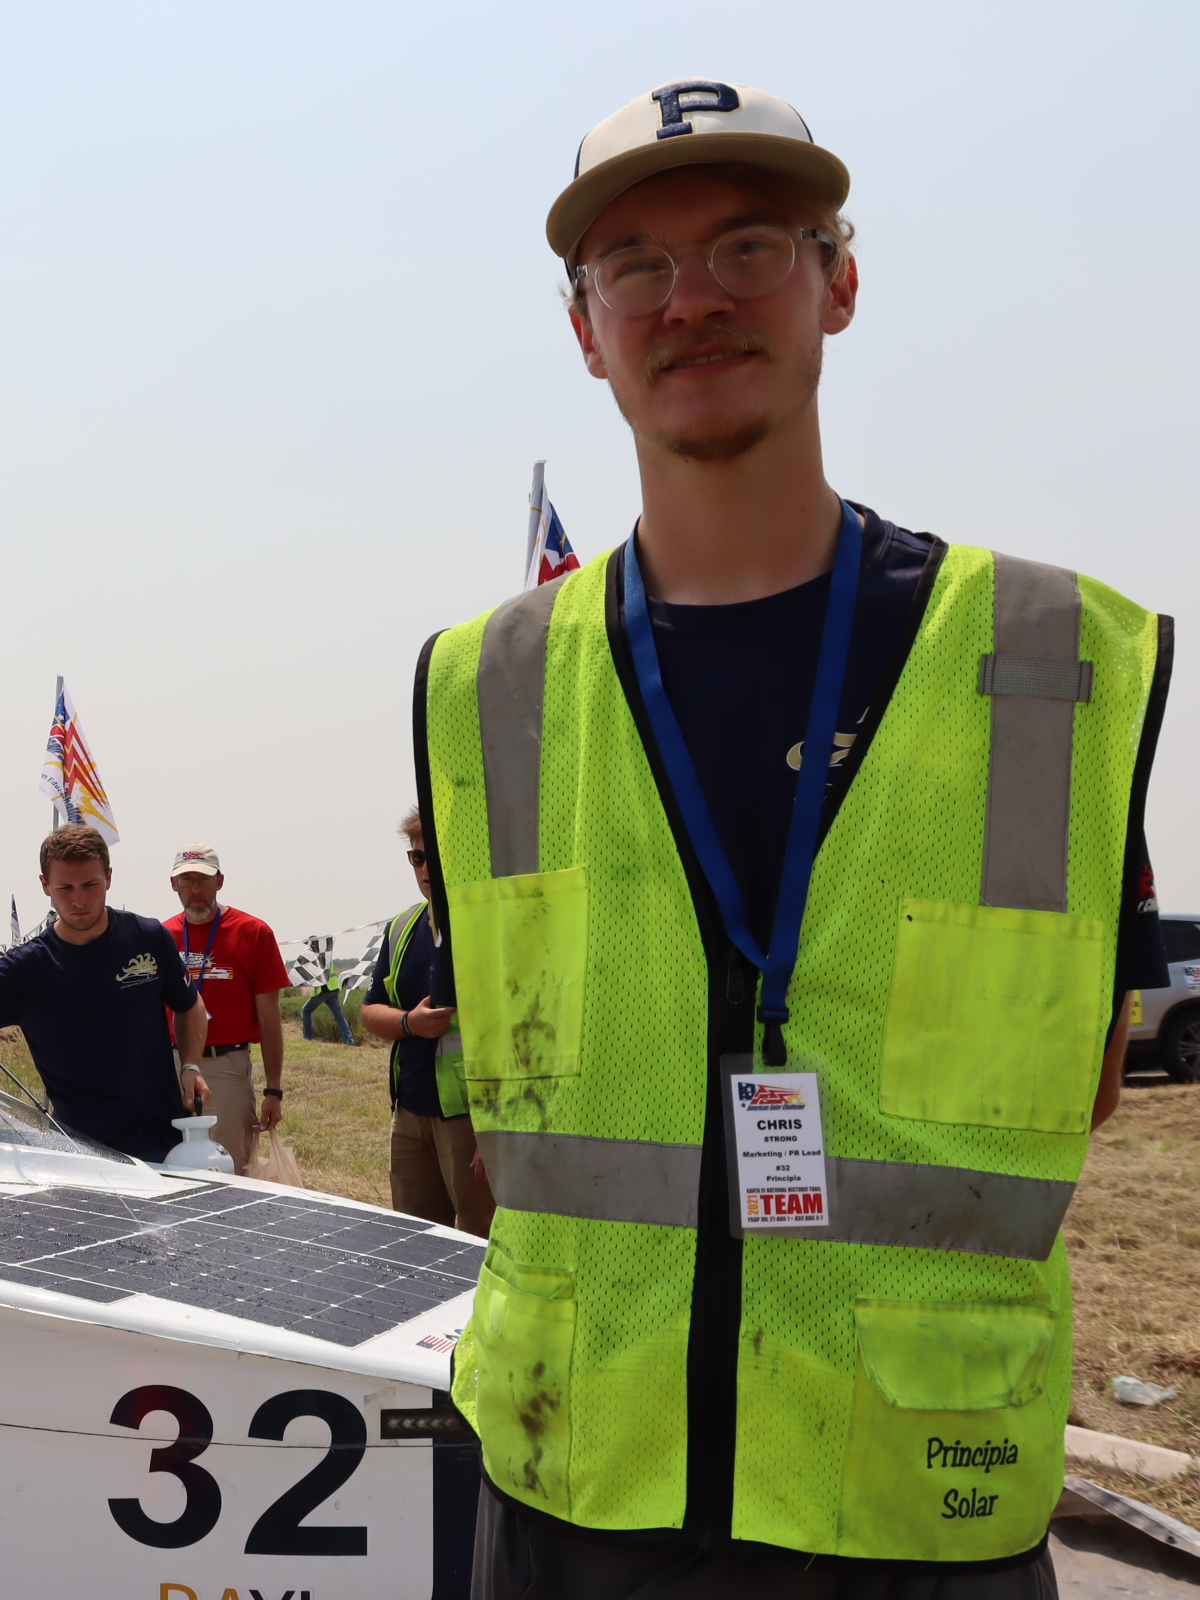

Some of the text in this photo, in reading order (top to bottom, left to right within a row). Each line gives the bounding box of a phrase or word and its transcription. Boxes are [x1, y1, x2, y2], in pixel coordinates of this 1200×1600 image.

[651, 80, 740, 140] P
[757, 1119, 802, 1130] CHRIS
[747, 1195, 759, 1215] 2021
[760, 1193, 823, 1215] TEAM
[107, 1384, 367, 1557] 32
[927, 1437, 1019, 1473] Principia
[941, 1487, 999, 1519] Solar
